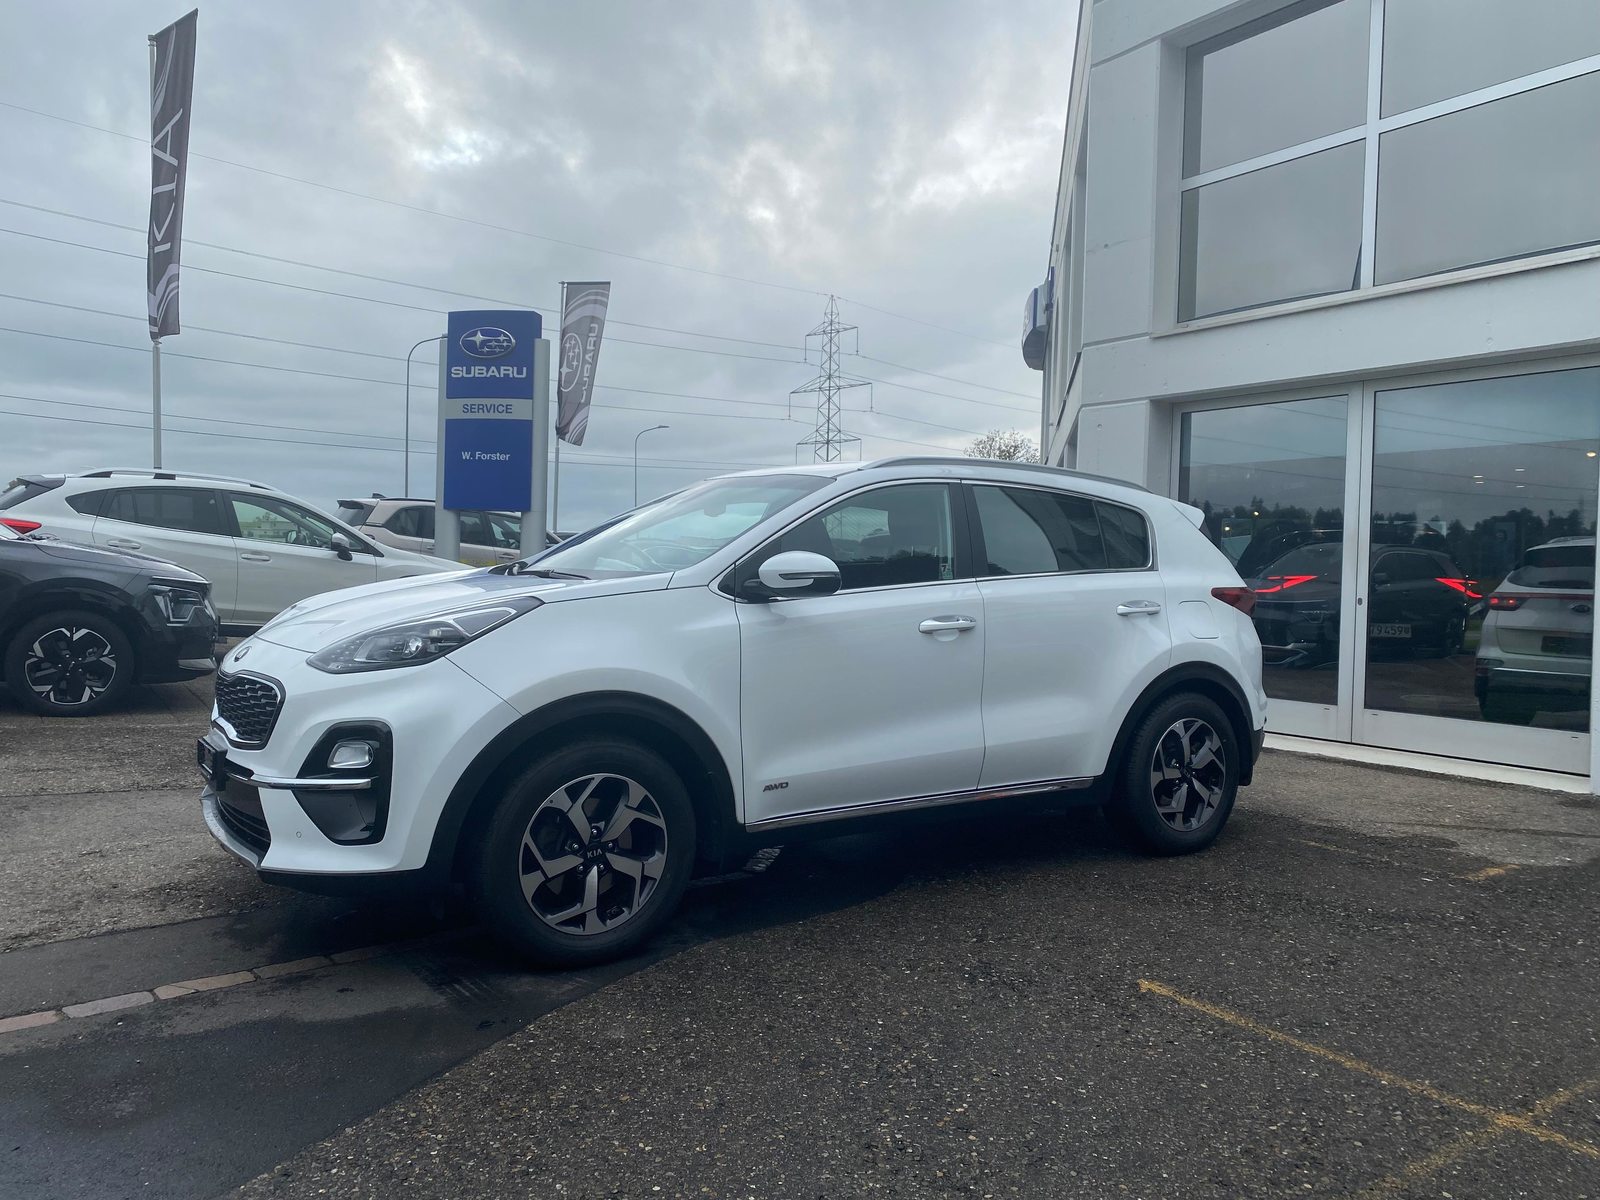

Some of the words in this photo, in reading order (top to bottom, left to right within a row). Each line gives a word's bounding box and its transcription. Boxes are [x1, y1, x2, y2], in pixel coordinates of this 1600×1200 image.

[450, 366, 527, 378] SUBARU
[462, 403, 513, 414] SERVICE
[461, 451, 473, 461] W.
[475, 451, 511, 461] Forster
[762, 781, 789, 793] AWD
[586, 848, 603, 859] KIA
